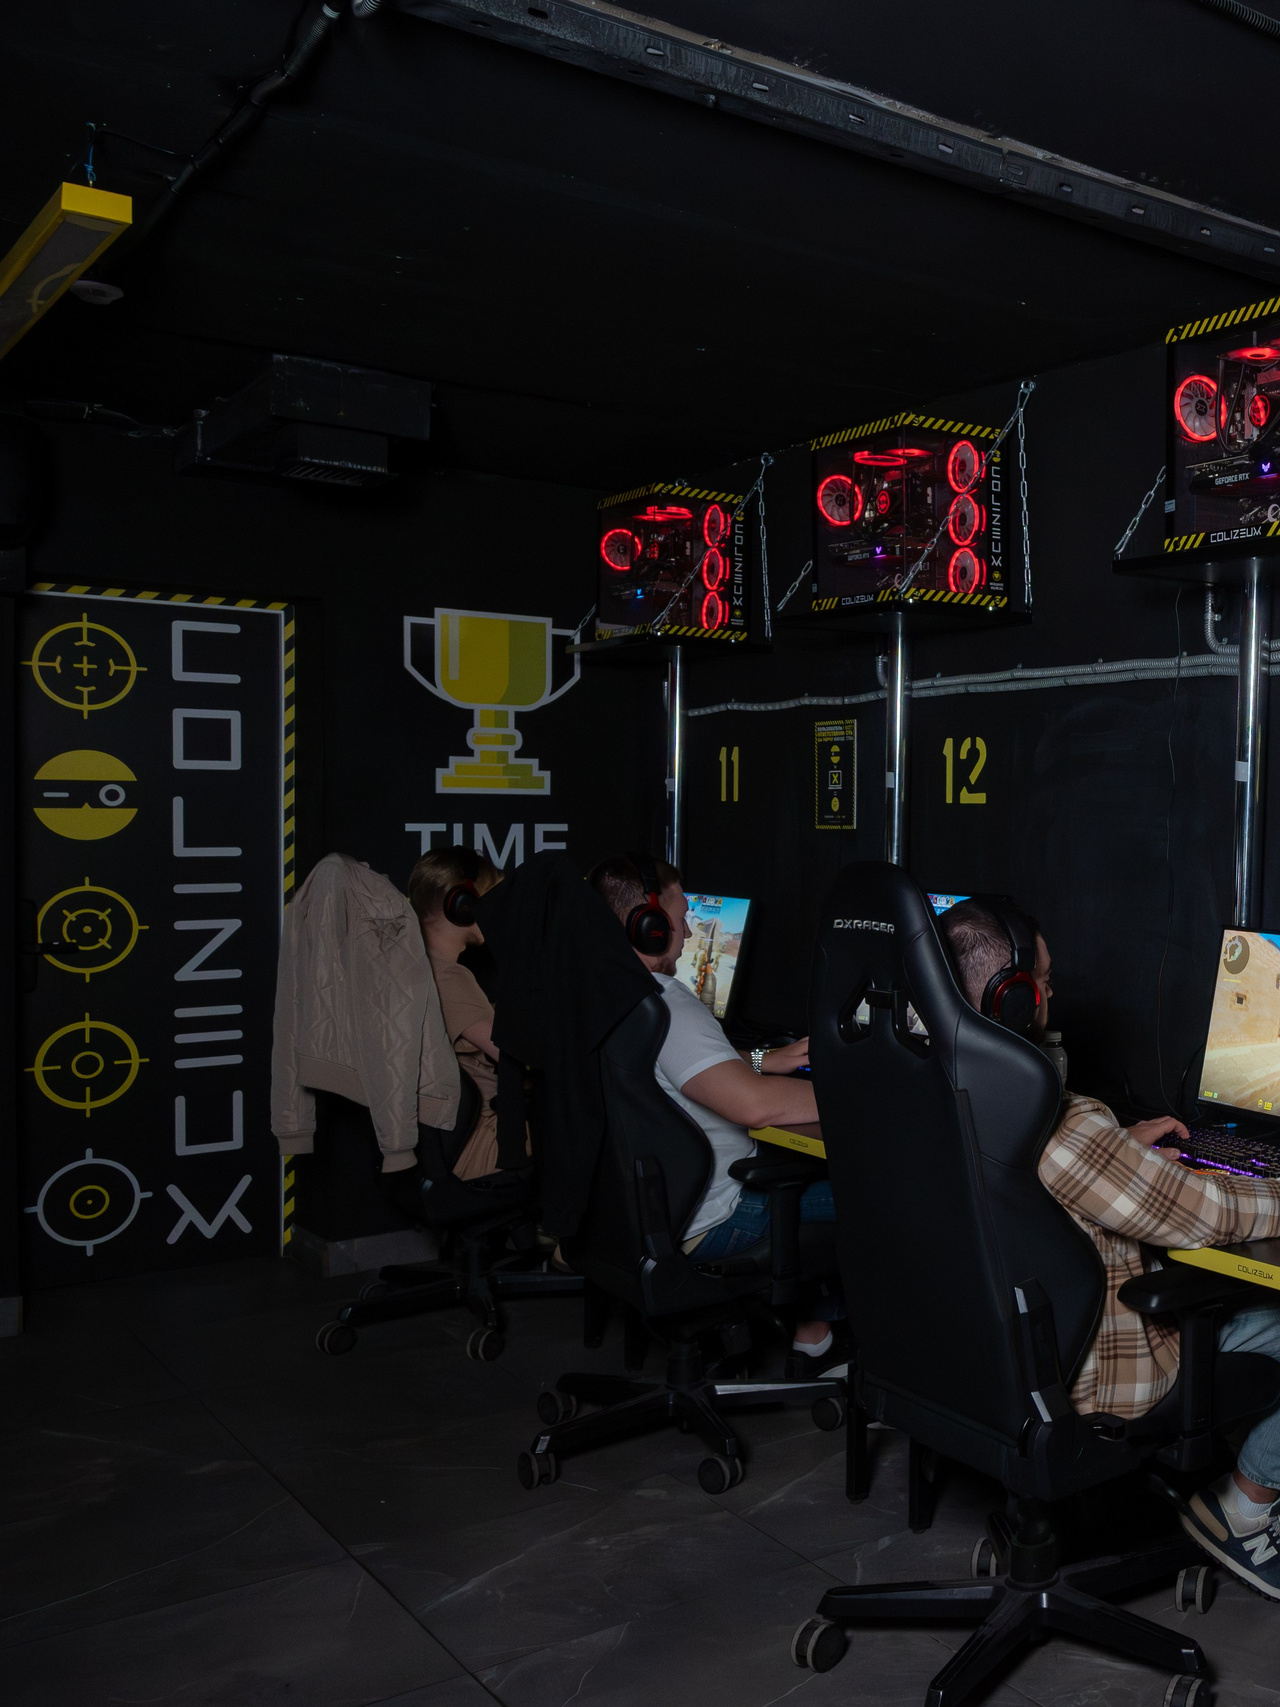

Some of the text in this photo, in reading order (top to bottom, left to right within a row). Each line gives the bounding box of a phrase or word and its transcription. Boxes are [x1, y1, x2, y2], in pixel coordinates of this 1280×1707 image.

[1214, 472, 1250, 486] GEFORCE RTX
[990, 465, 1002, 567] COLIZEUM
[1210, 525, 1262, 543] COLIZEUM
[732, 523, 744, 607] COLIZEUM
[841, 594, 874, 606] COLIZEUM
[718, 745, 740, 802] 11
[942, 736, 988, 804] 12
[166, 618, 254, 1245] COLIZEUM
[832, 917, 895, 935] DXRACER
[1237, 1264, 1274, 1281] COLIZEUM
